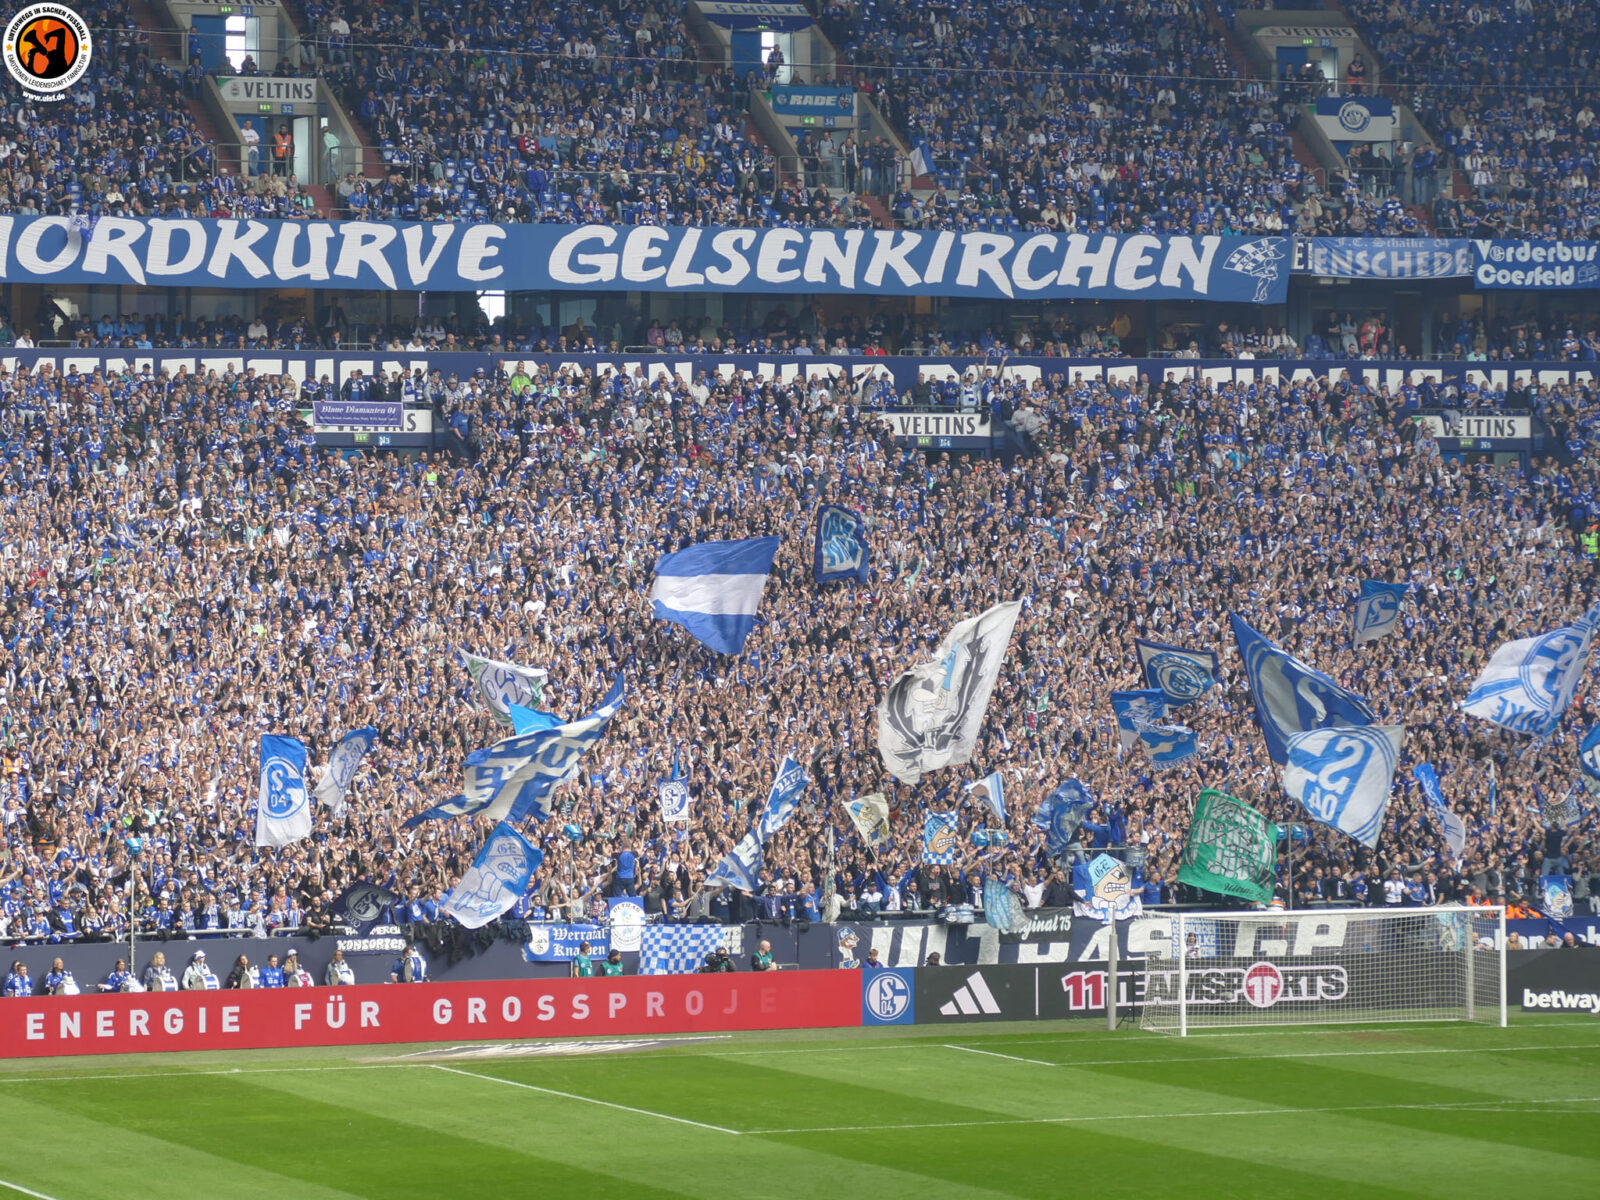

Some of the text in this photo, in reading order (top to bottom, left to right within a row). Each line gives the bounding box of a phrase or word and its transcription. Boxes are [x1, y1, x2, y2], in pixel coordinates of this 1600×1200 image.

[715, 3, 808, 14] SCHALKE
[1280, 27, 1352, 37] VELTINS
[244, 82, 313, 99] VELTINS
[282, 105, 293, 113] 32
[789, 95, 837, 106] RADE
[548, 224, 1221, 299] GELSENKIRCHEN
[1314, 247, 1469, 277] ENSCHEDE
[1477, 264, 1575, 286] Coesfeld
[321, 405, 344, 413] Blaue
[345, 405, 386, 414] Diamanten
[900, 416, 976, 435] VELTINS
[553, 943, 606, 957] Knaen
[1523, 988, 1600, 1013] betway
[26, 1006, 241, 1040] ENERGIE
[294, 995, 380, 1031] FÜR
